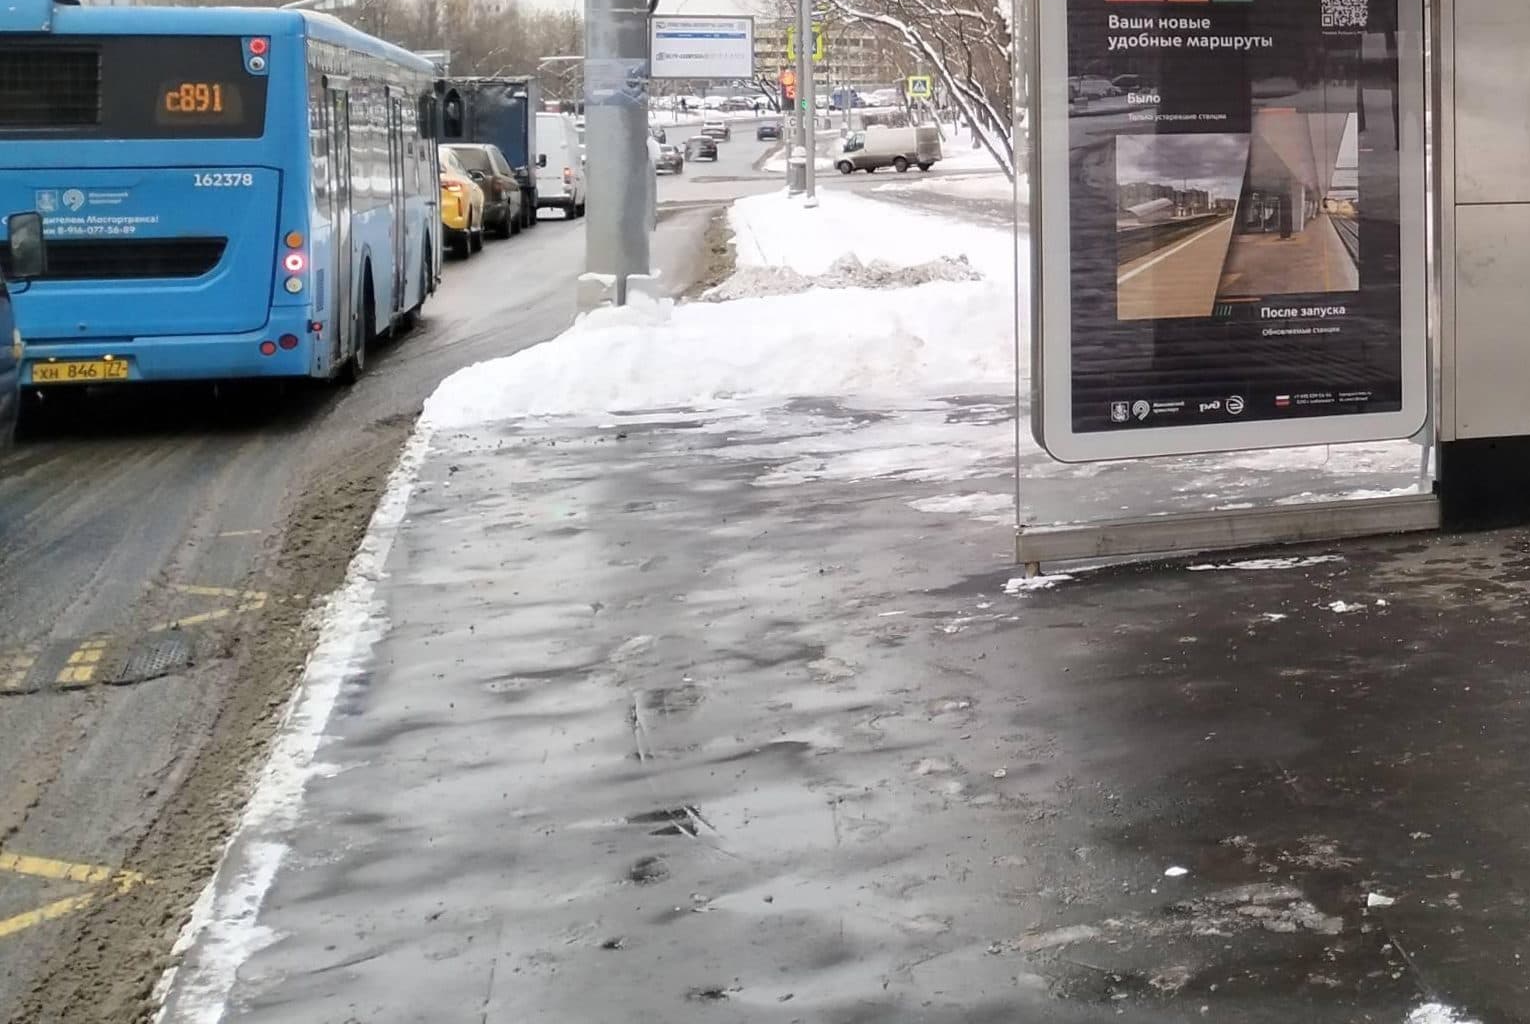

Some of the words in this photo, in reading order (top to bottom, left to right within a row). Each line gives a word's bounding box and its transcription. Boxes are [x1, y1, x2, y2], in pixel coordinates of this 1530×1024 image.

[1108, 15, 1153, 29] Ваши
[1158, 18, 1211, 29] новые
[1108, 33, 1182, 50] удобные
[1187, 36, 1273, 51] маршруты
[1127, 93, 1160, 104] Было
[194, 174, 253, 186] 162378
[1261, 307, 1298, 318] После
[1300, 305, 1346, 317] запуска
[67, 363, 97, 378] 846
